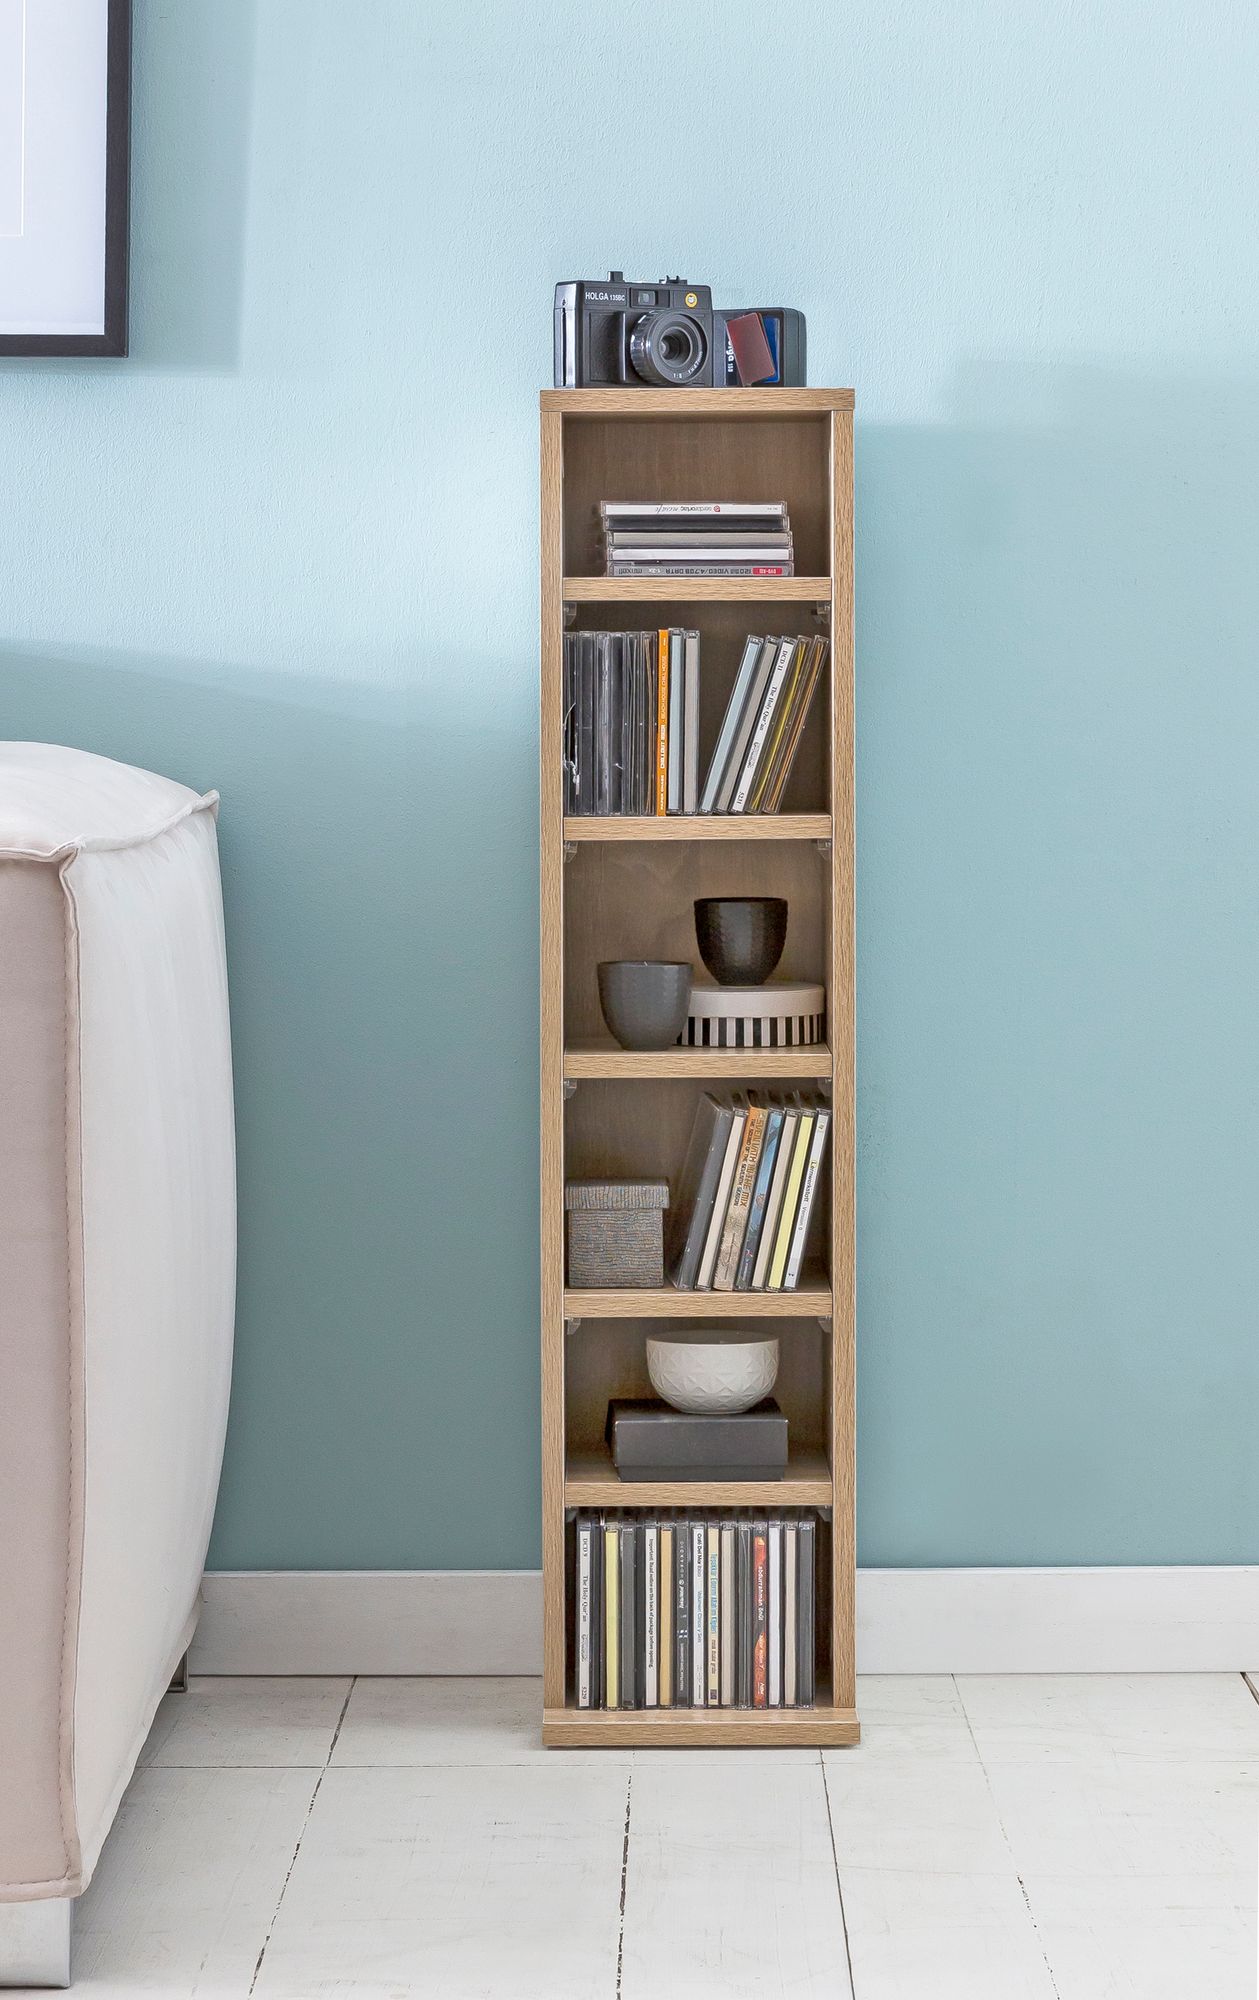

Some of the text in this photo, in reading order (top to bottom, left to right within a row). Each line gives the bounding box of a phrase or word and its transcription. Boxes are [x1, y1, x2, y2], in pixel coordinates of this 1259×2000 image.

[585, 291, 609, 301] HOLGA
[780, 650, 788, 664] DCD
[764, 697, 773, 710] Holy
[803, 1161, 817, 1202] Lernwerkstatt
[732, 1185, 742, 1206] SEASON
[738, 1190, 749, 1207] MIX
